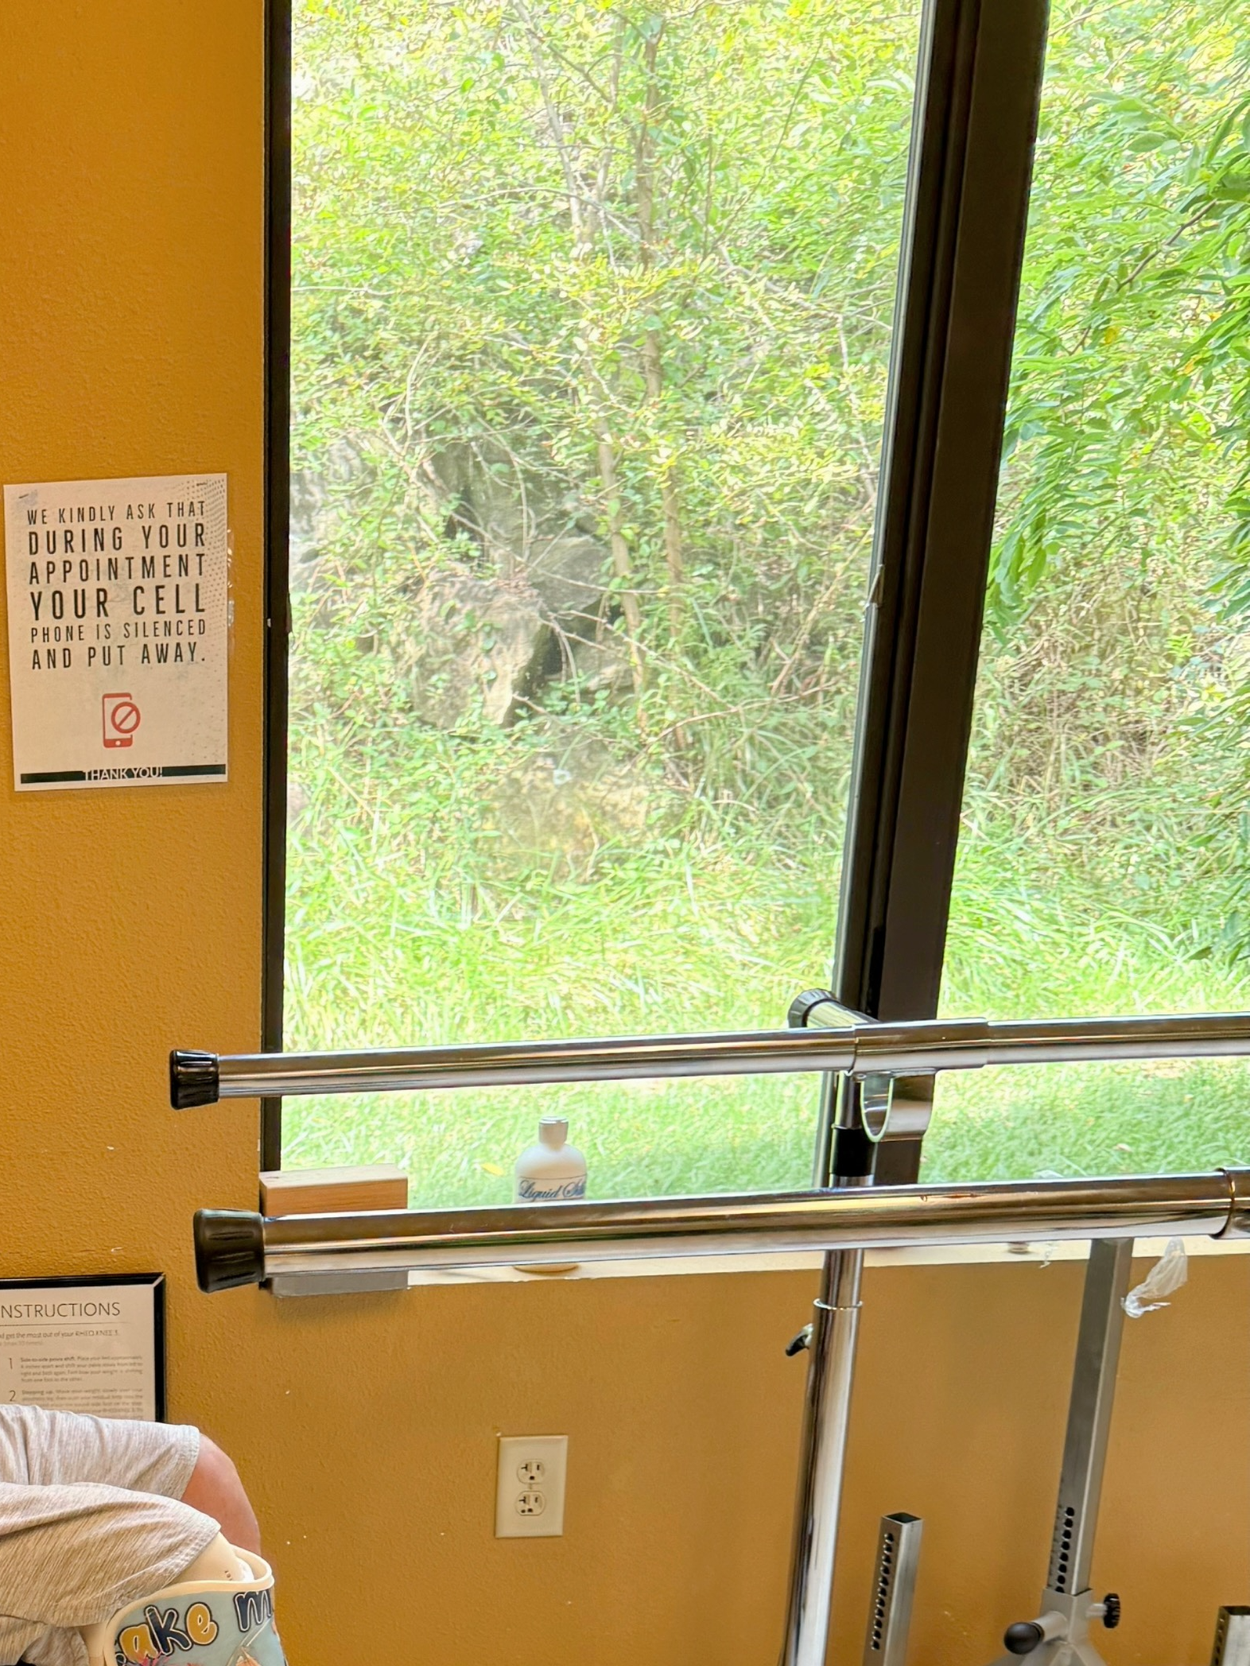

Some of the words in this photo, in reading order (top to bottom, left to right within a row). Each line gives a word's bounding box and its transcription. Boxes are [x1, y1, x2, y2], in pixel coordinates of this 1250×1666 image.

[27, 509, 48, 525] WE
[58, 505, 116, 524] KINDLY
[126, 503, 156, 520] ASK
[166, 501, 205, 518] THAT
[28, 527, 123, 555] DURING
[142, 522, 206, 549] YOUR
[29, 554, 206, 585] APPOINTMENT
[30, 588, 109, 621] YOUR
[132, 583, 206, 616] CELL
[31, 625, 84, 644] PHONE
[96, 624, 111, 640] IS
[123, 619, 206, 638] SILENCED
[32, 648, 72, 670] AND
[87, 645, 126, 667] PUT
[141, 642, 206, 664] AWAY.
[83, 768, 130, 781] THANK
[132, 766, 162, 779] YOU!
[519, 1180, 563, 1202] Liquid
[9, 1390, 16, 1402] 2
